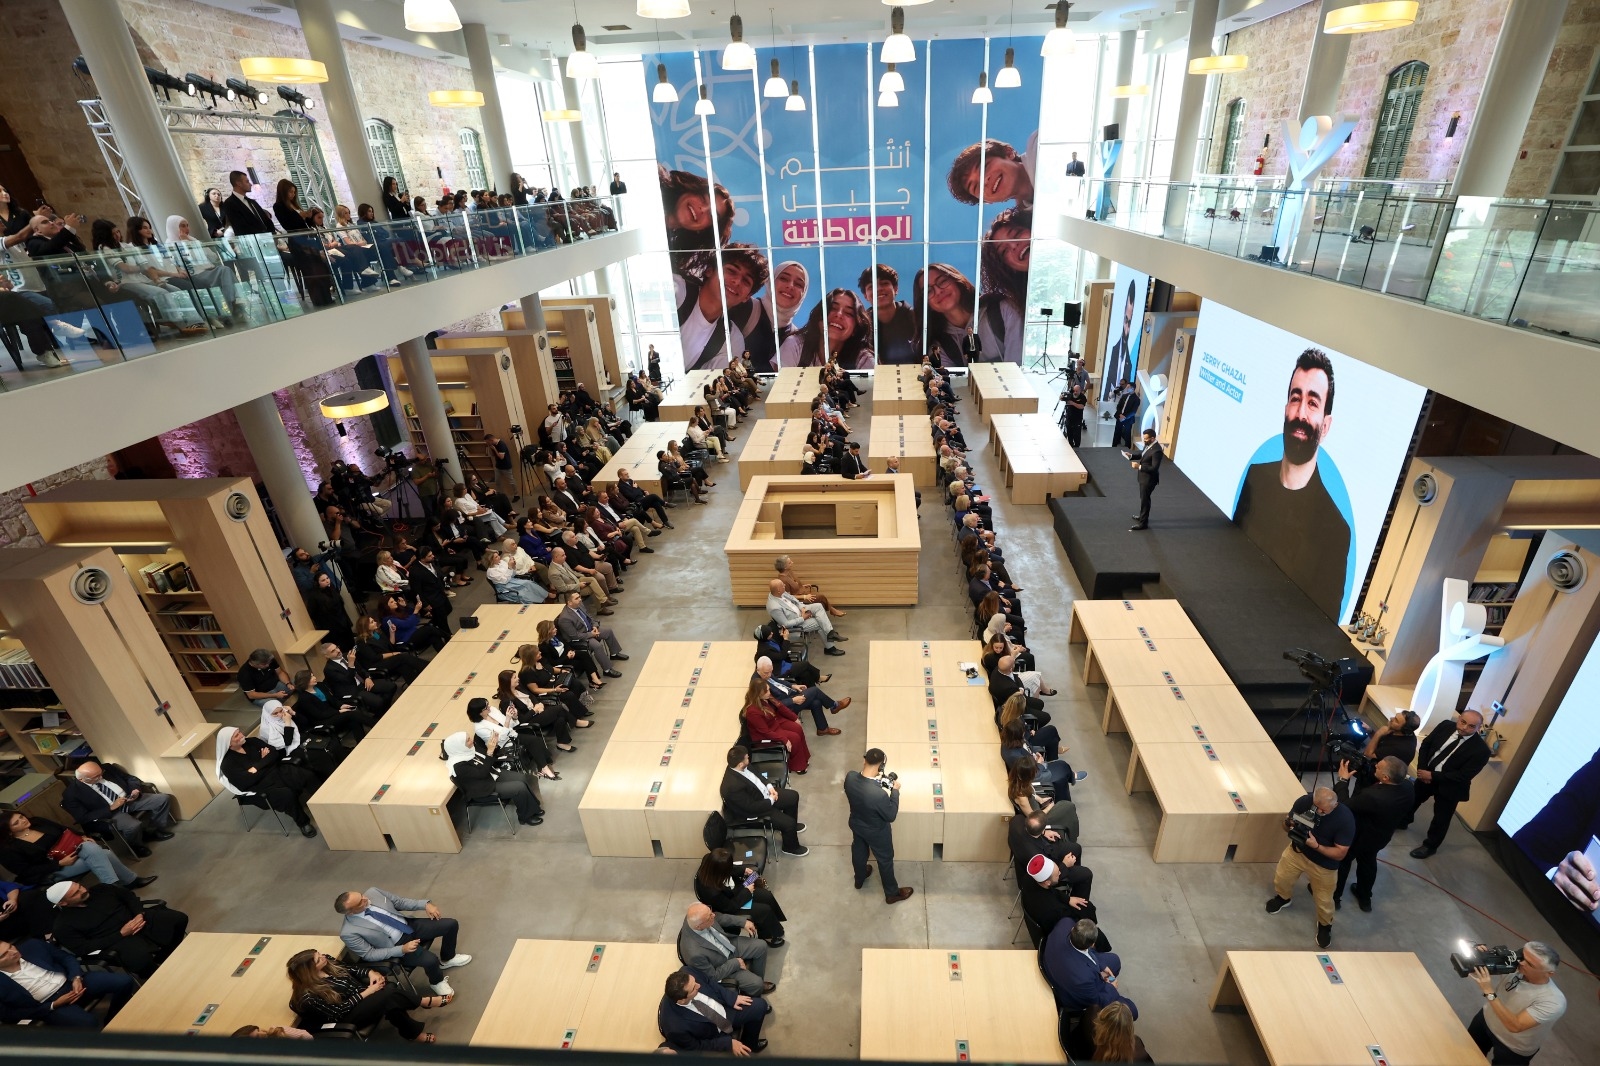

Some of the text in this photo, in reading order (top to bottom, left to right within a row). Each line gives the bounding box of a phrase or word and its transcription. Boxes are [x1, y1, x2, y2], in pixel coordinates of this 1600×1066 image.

[782, 184, 911, 213] جيل
[1200, 366, 1241, 400] Writer and Actor
[1202, 351, 1247, 386] JERRY GHAZAL
